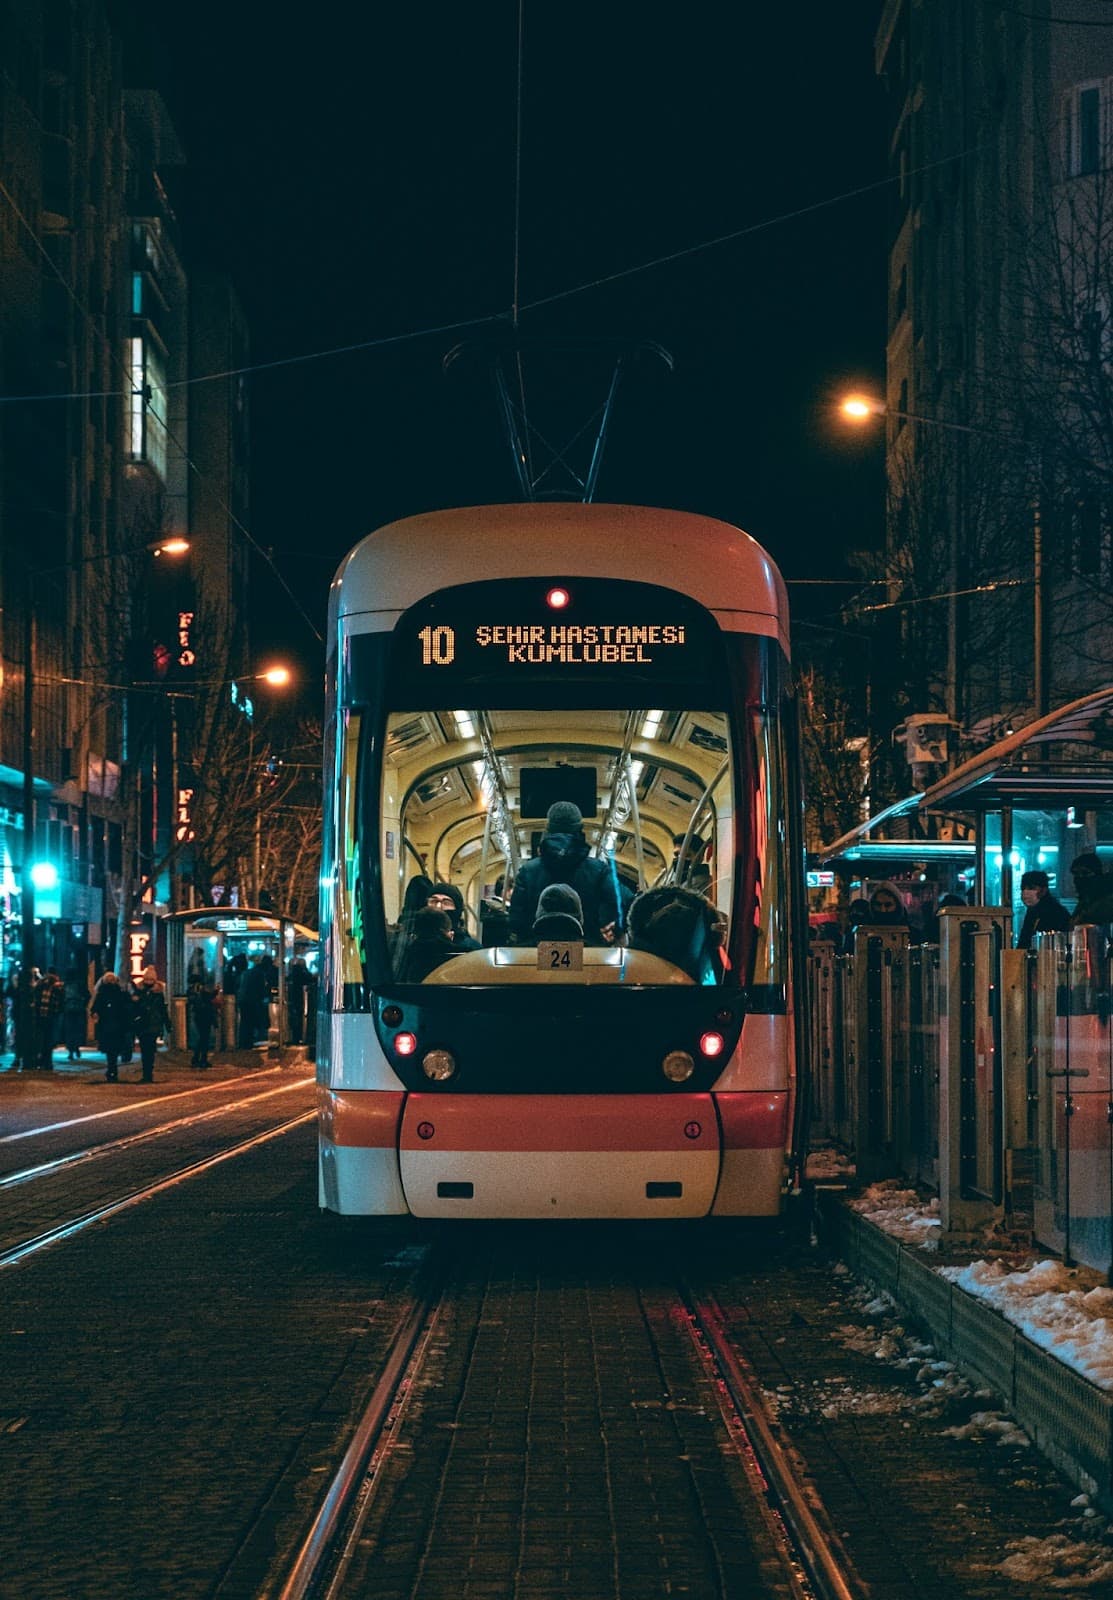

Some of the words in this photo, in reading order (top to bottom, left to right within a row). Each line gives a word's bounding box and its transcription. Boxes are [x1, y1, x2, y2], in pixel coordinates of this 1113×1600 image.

[418, 626, 455, 665] 10
[508, 644, 653, 663] KUMLUBEL
[129, 933, 150, 985] FL
[551, 949, 571, 968] 24
